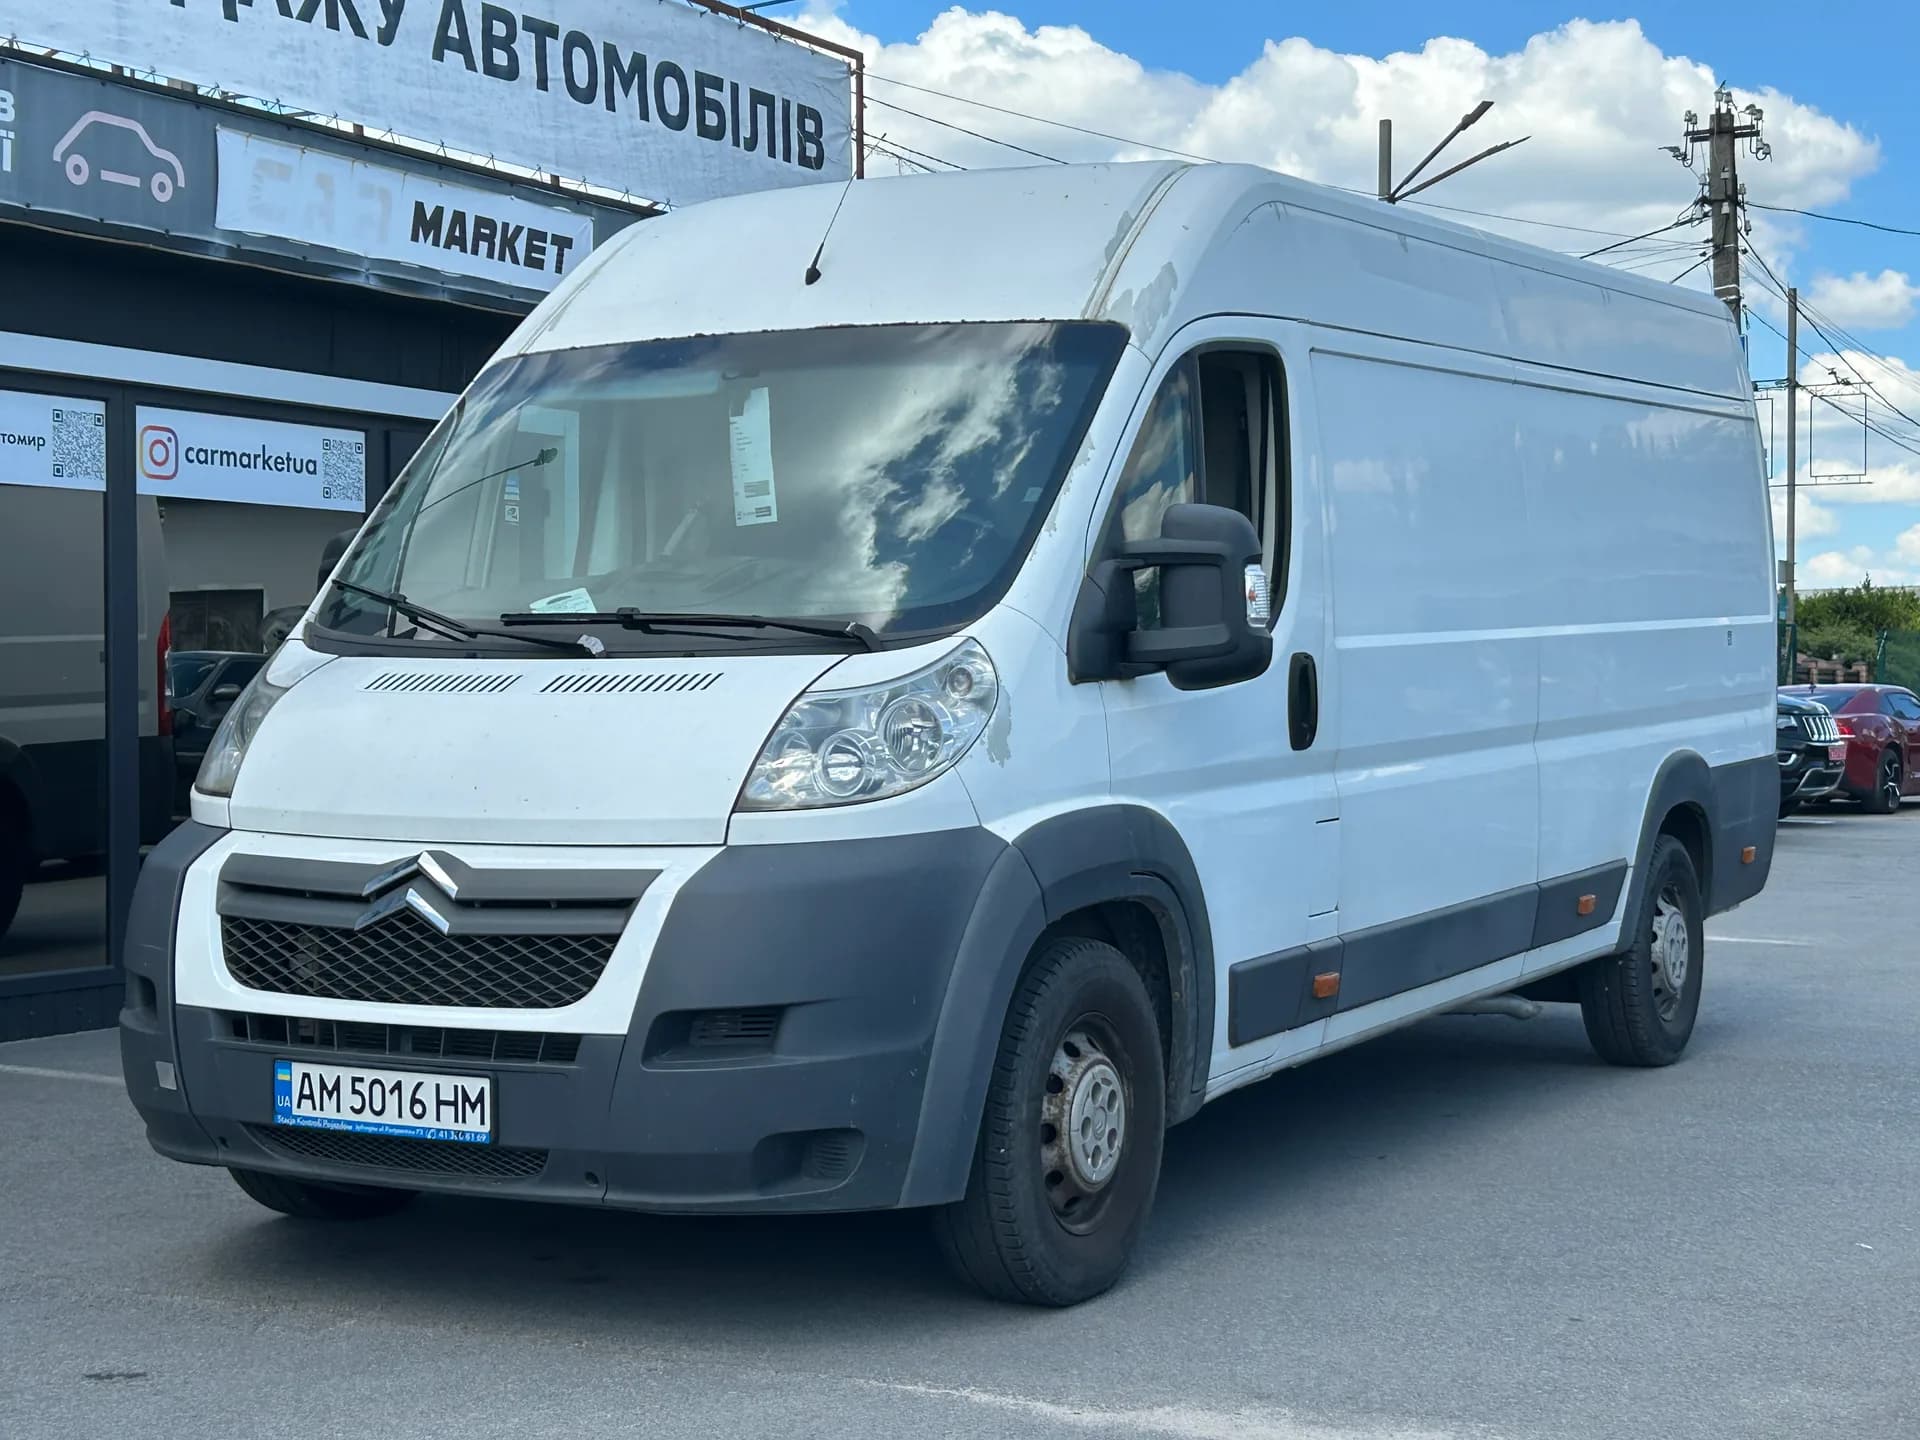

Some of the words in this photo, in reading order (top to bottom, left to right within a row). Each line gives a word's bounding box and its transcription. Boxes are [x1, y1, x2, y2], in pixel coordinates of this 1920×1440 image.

[432, 0, 824, 171] АВТОМОБІЛІВ
[410, 200, 574, 275] MARKET
[0, 432, 46, 452] томир
[185, 444, 318, 476] carmarketua
[277, 1095, 291, 1107] UA
[296, 1071, 341, 1113] AM
[349, 1076, 427, 1120] 5016
[435, 1083, 485, 1126] HM
